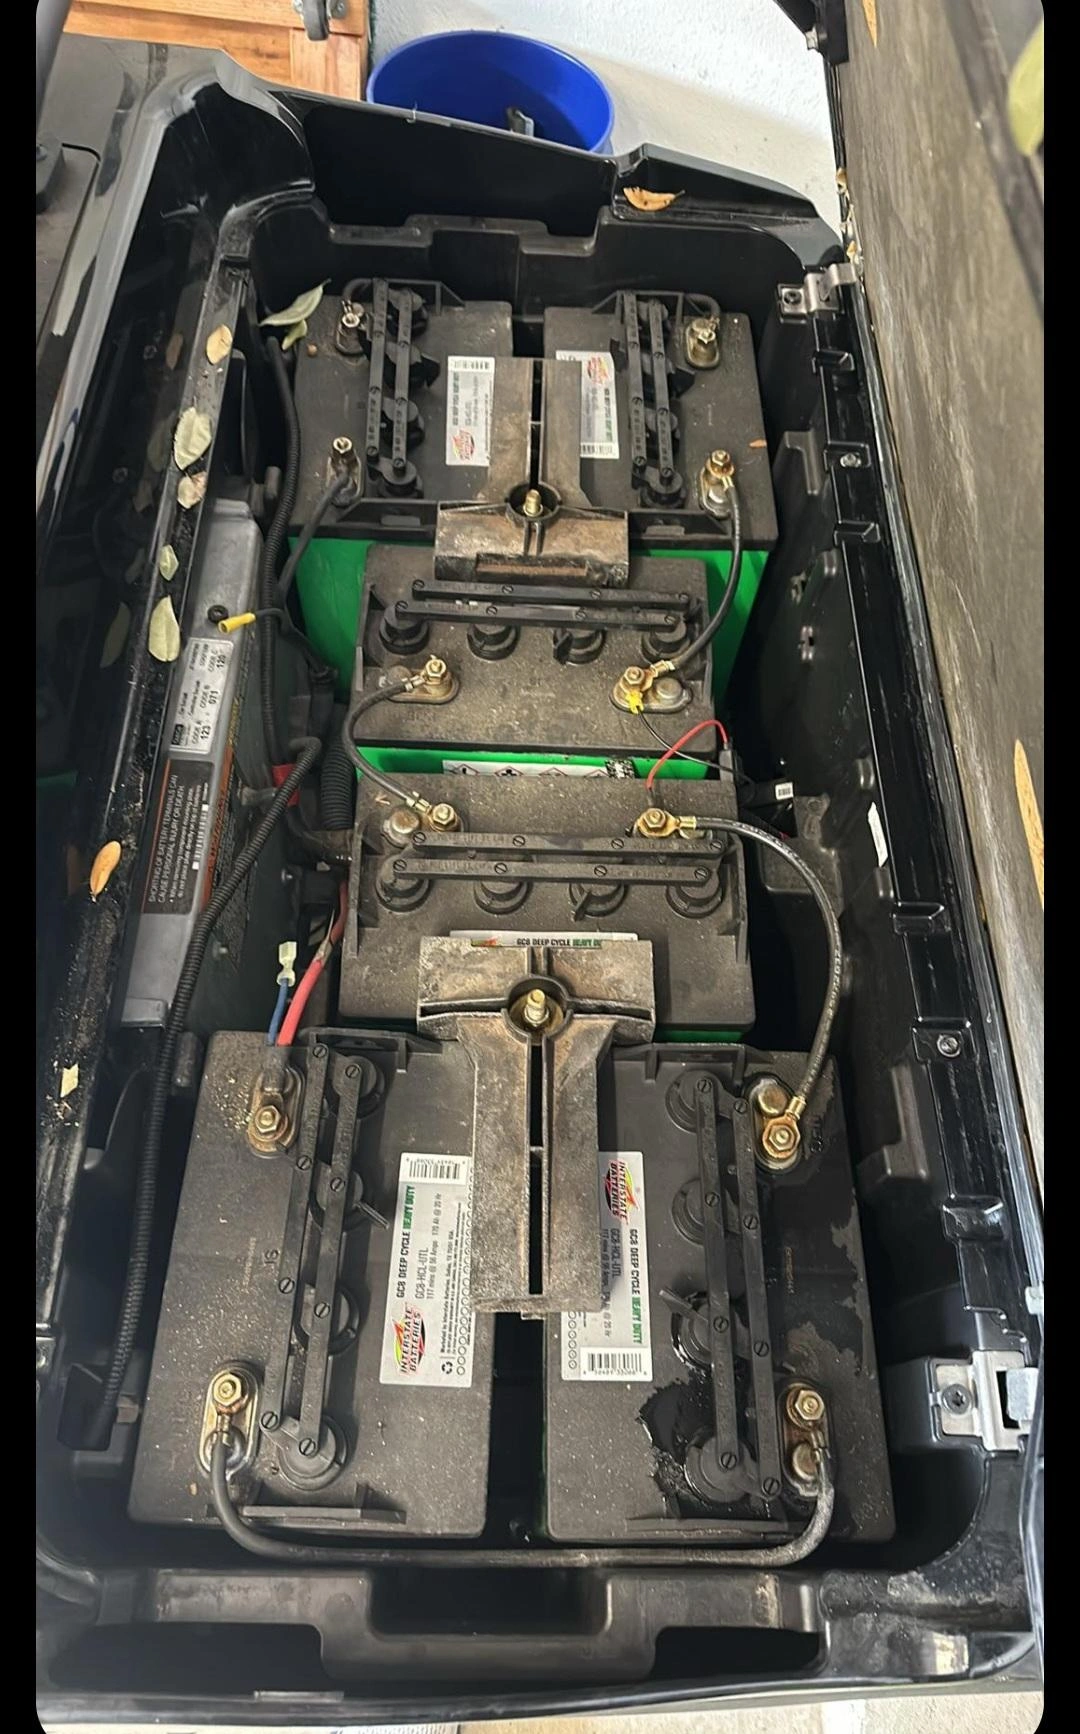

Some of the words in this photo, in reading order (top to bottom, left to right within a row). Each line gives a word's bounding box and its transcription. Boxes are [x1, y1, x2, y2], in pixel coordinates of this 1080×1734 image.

[200, 725, 210, 739] 123
[532, 938, 550, 946] DEEP
[550, 938, 571, 946] CYCLE
[404, 1185, 414, 1204] DUTY
[610, 1163, 619, 1215] BATTERIES
[618, 1161, 627, 1218] INTERSTATE
[403, 1205, 412, 1228] HEAVY
[400, 1232, 409, 1255] CYCLE
[629, 1229, 637, 1244] GC8
[398, 1257, 407, 1277] DEEP
[630, 1247, 638, 1267] DEEP
[415, 1248, 428, 1298] GC8-HCL-UTL
[631, 1270, 639, 1293] CYCLE
[396, 1281, 405, 1297] GC8
[632, 1297, 640, 1321] HEAVY
[400, 1307, 411, 1372] INTERSTATE
[409, 1313, 420, 1371] BATTERIES
[632, 1323, 641, 1343] DUTY
